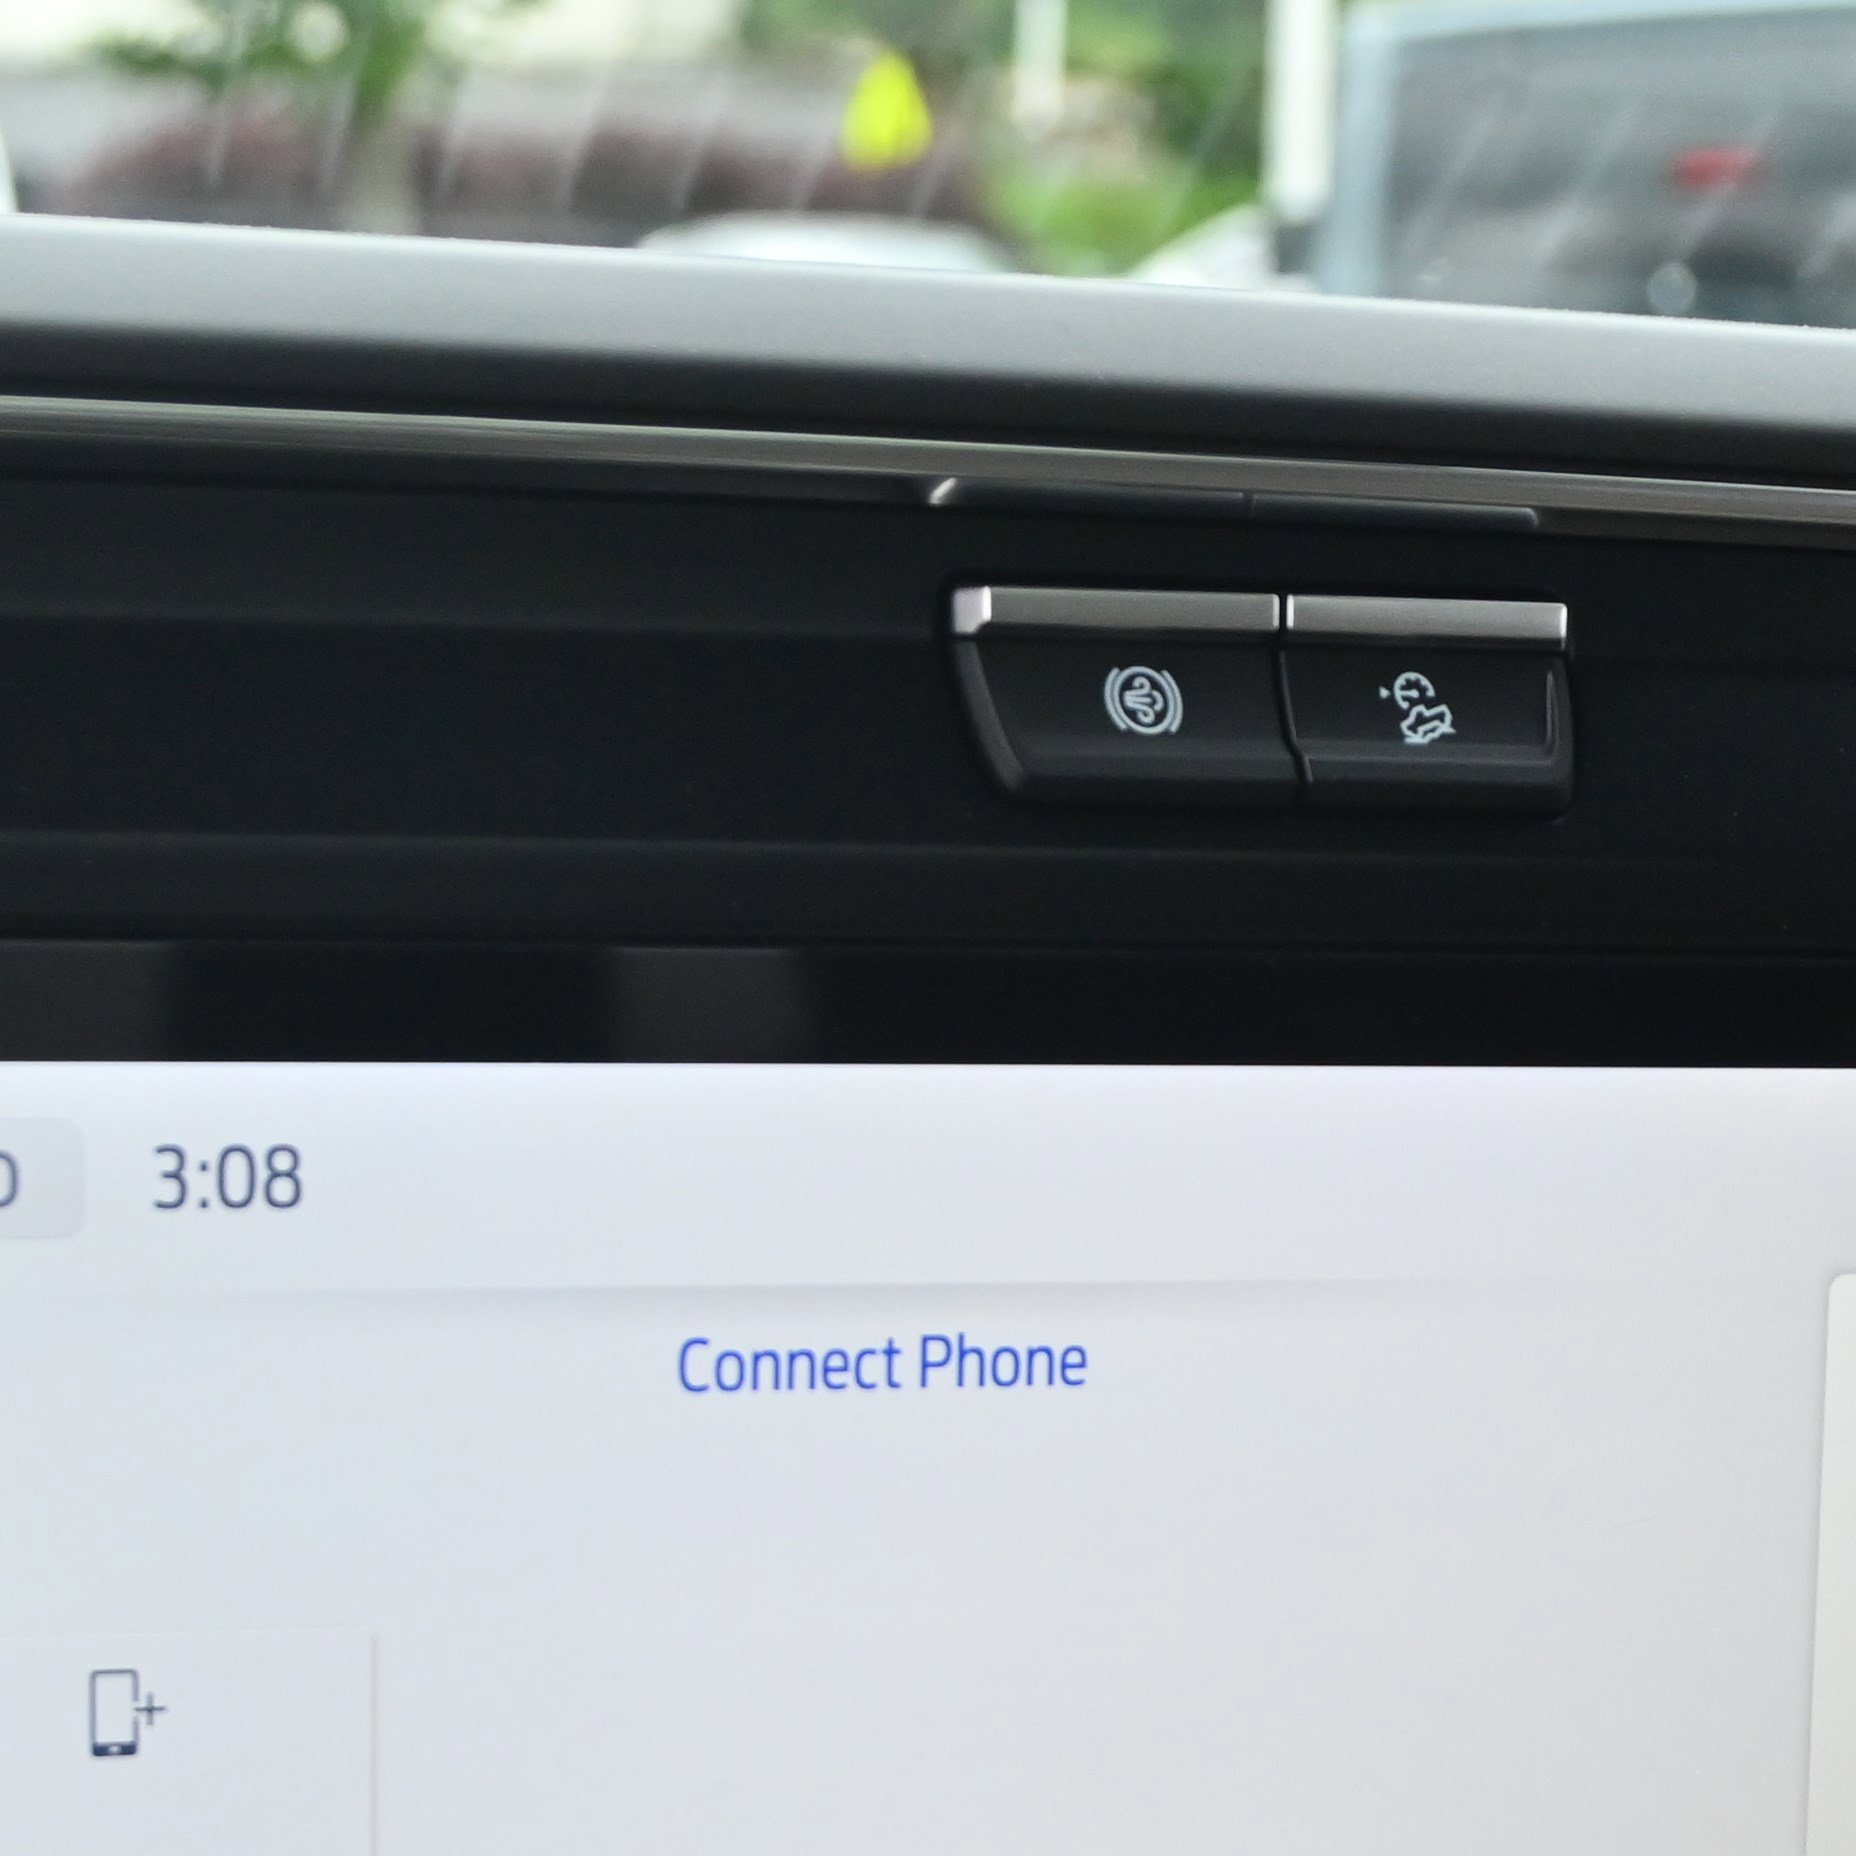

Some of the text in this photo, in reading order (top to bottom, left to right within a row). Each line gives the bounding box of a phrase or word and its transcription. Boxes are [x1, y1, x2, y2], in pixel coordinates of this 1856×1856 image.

[154, 1144, 302, 1211] 3:08
[678, 1333, 1087, 1393] Connect Phone
